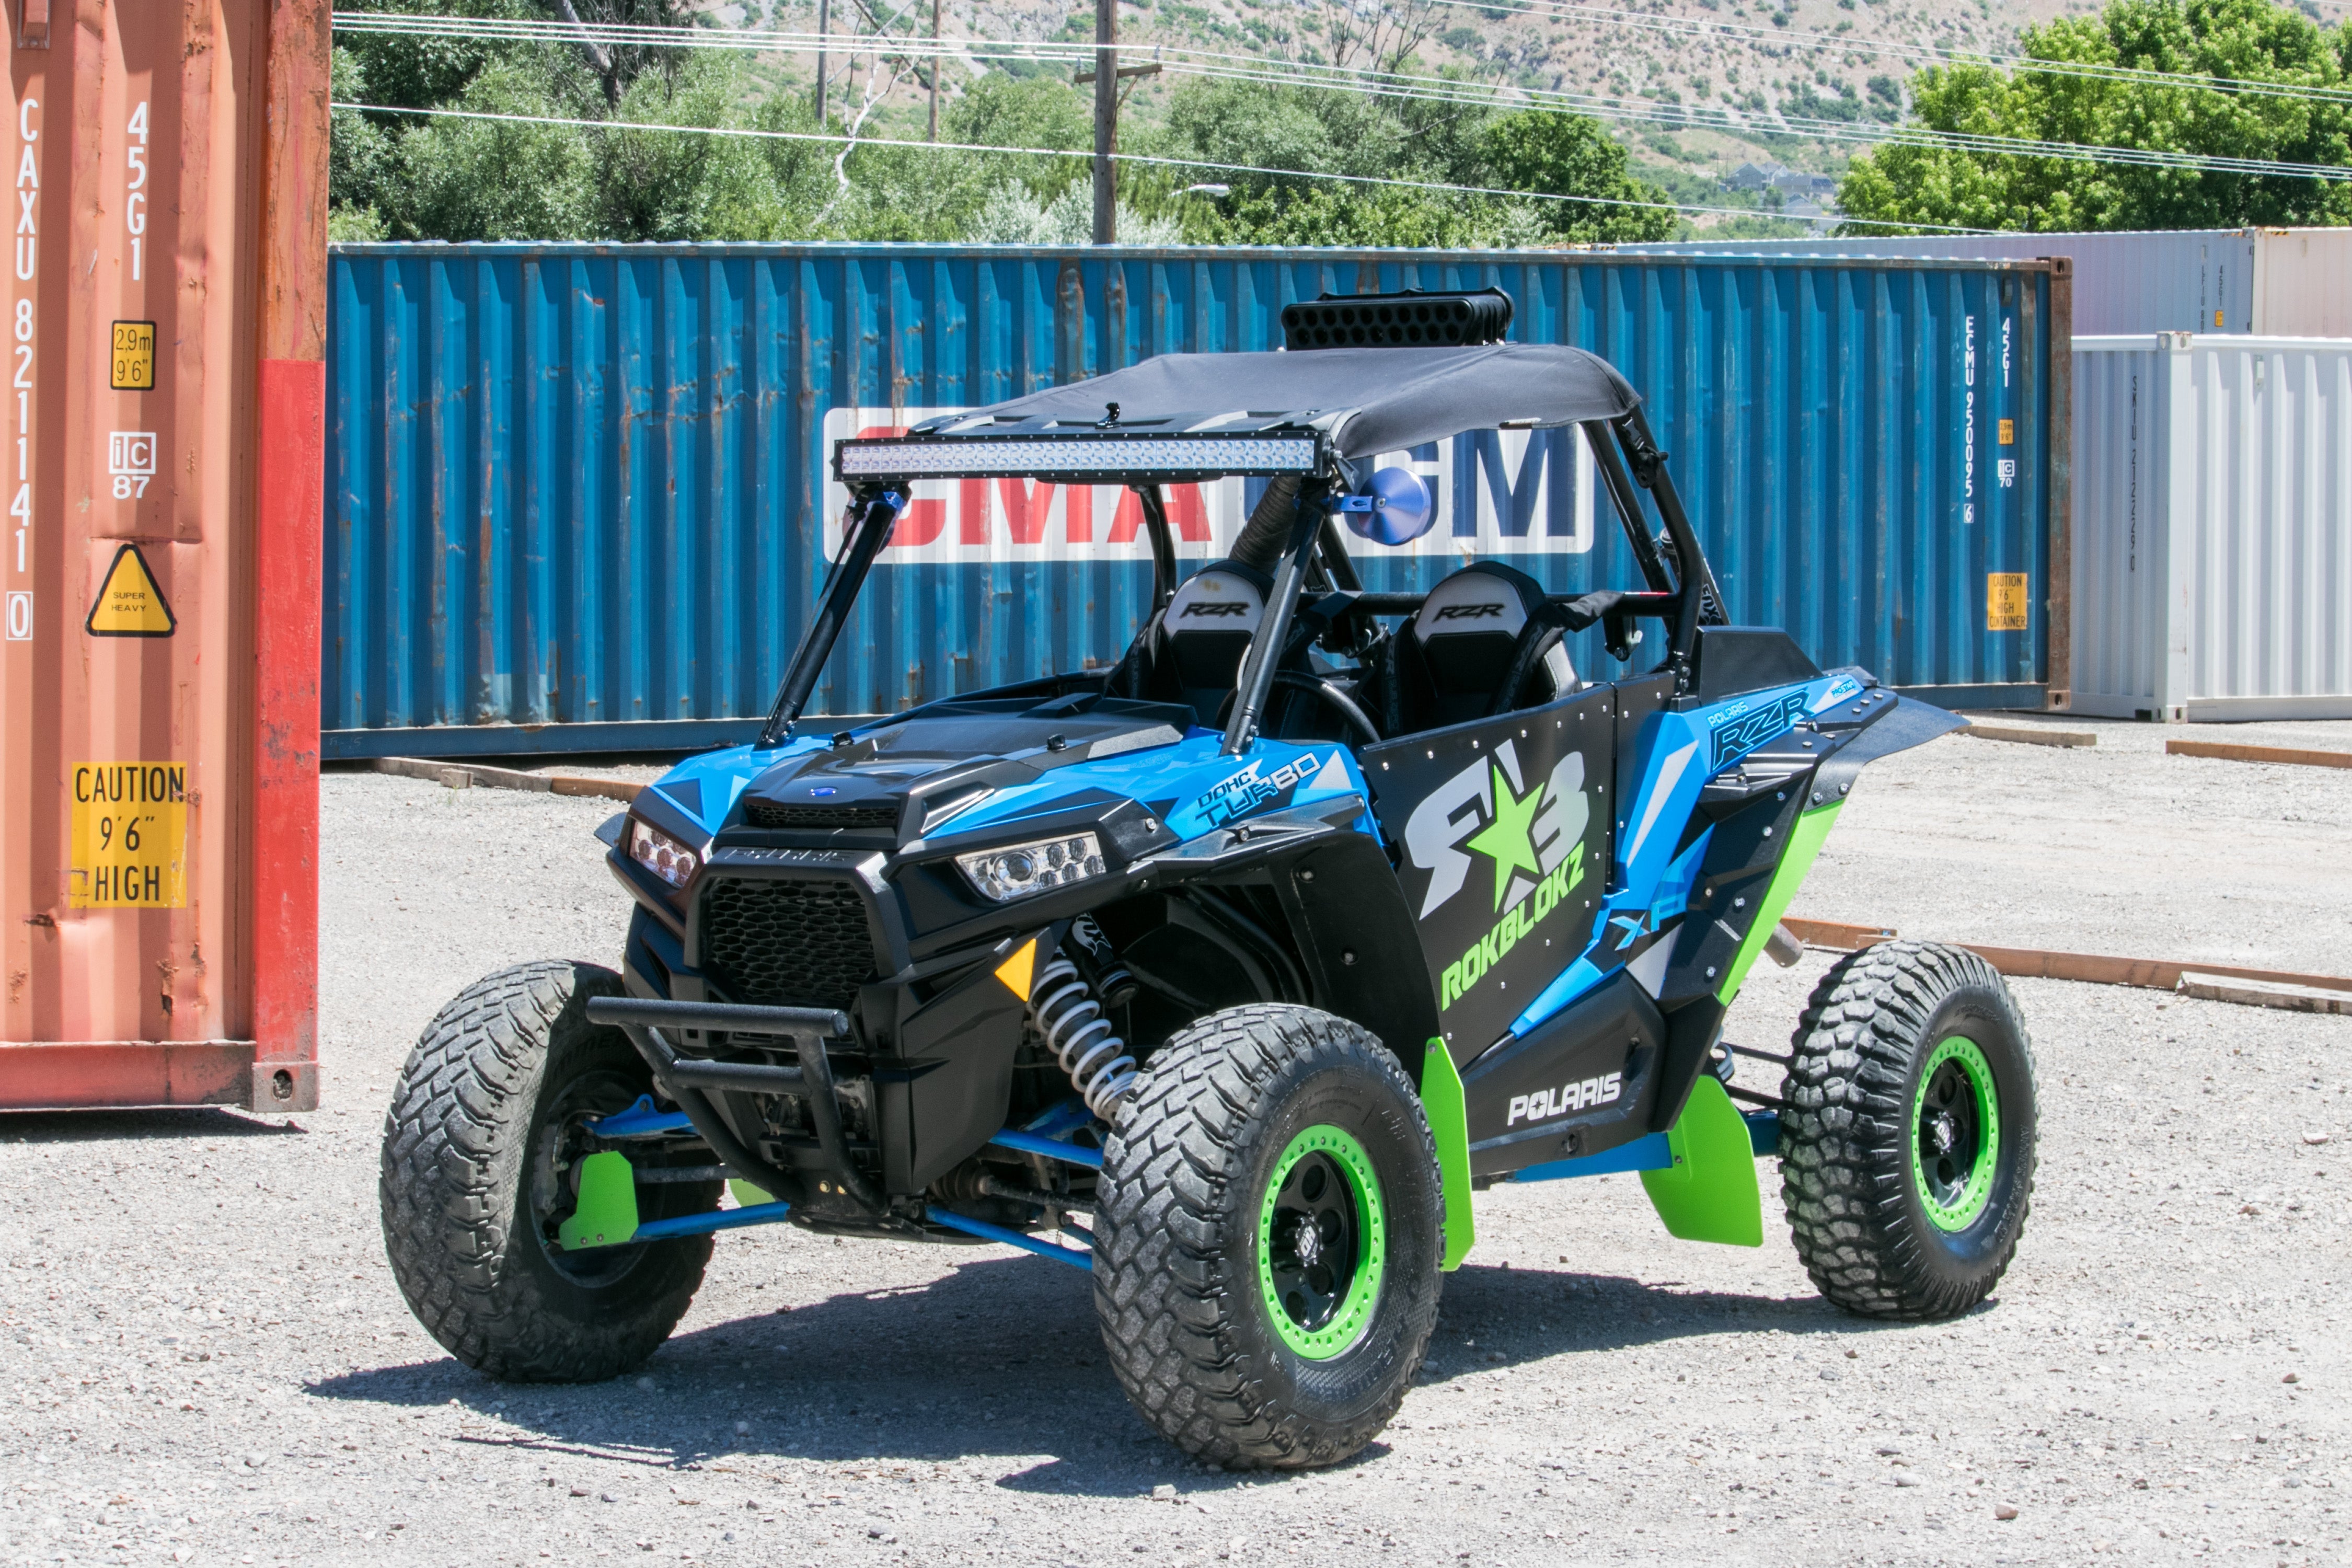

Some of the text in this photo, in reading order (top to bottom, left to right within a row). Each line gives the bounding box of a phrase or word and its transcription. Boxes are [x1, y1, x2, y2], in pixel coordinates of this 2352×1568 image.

[127, 102, 148, 281] 45G1
[10, 98, 38, 637] CAXU 821141 0
[1964, 316, 1974, 522] ECMU 950095 6
[112, 476, 149, 499] 87
[1999, 478, 2012, 487] 70
[1993, 575, 2022, 586] CAUTION
[1179, 602, 1251, 619] RZR
[1432, 603, 1507, 624] RZR
[1989, 616, 2025, 627] CONTAINER
[1997, 602, 2014, 614] HIGH
[1708, 701, 1749, 727] POLARIS
[1711, 688, 1815, 771] RZR
[76, 766, 185, 802] CAUTION
[1195, 752, 1322, 829] TURBO
[1197, 771, 1251, 809] DOHC
[95, 866, 159, 901] HIGH
[1442, 841, 1585, 1011] ROKBLOKZ
[1507, 1071, 1621, 1126] POLARIS
